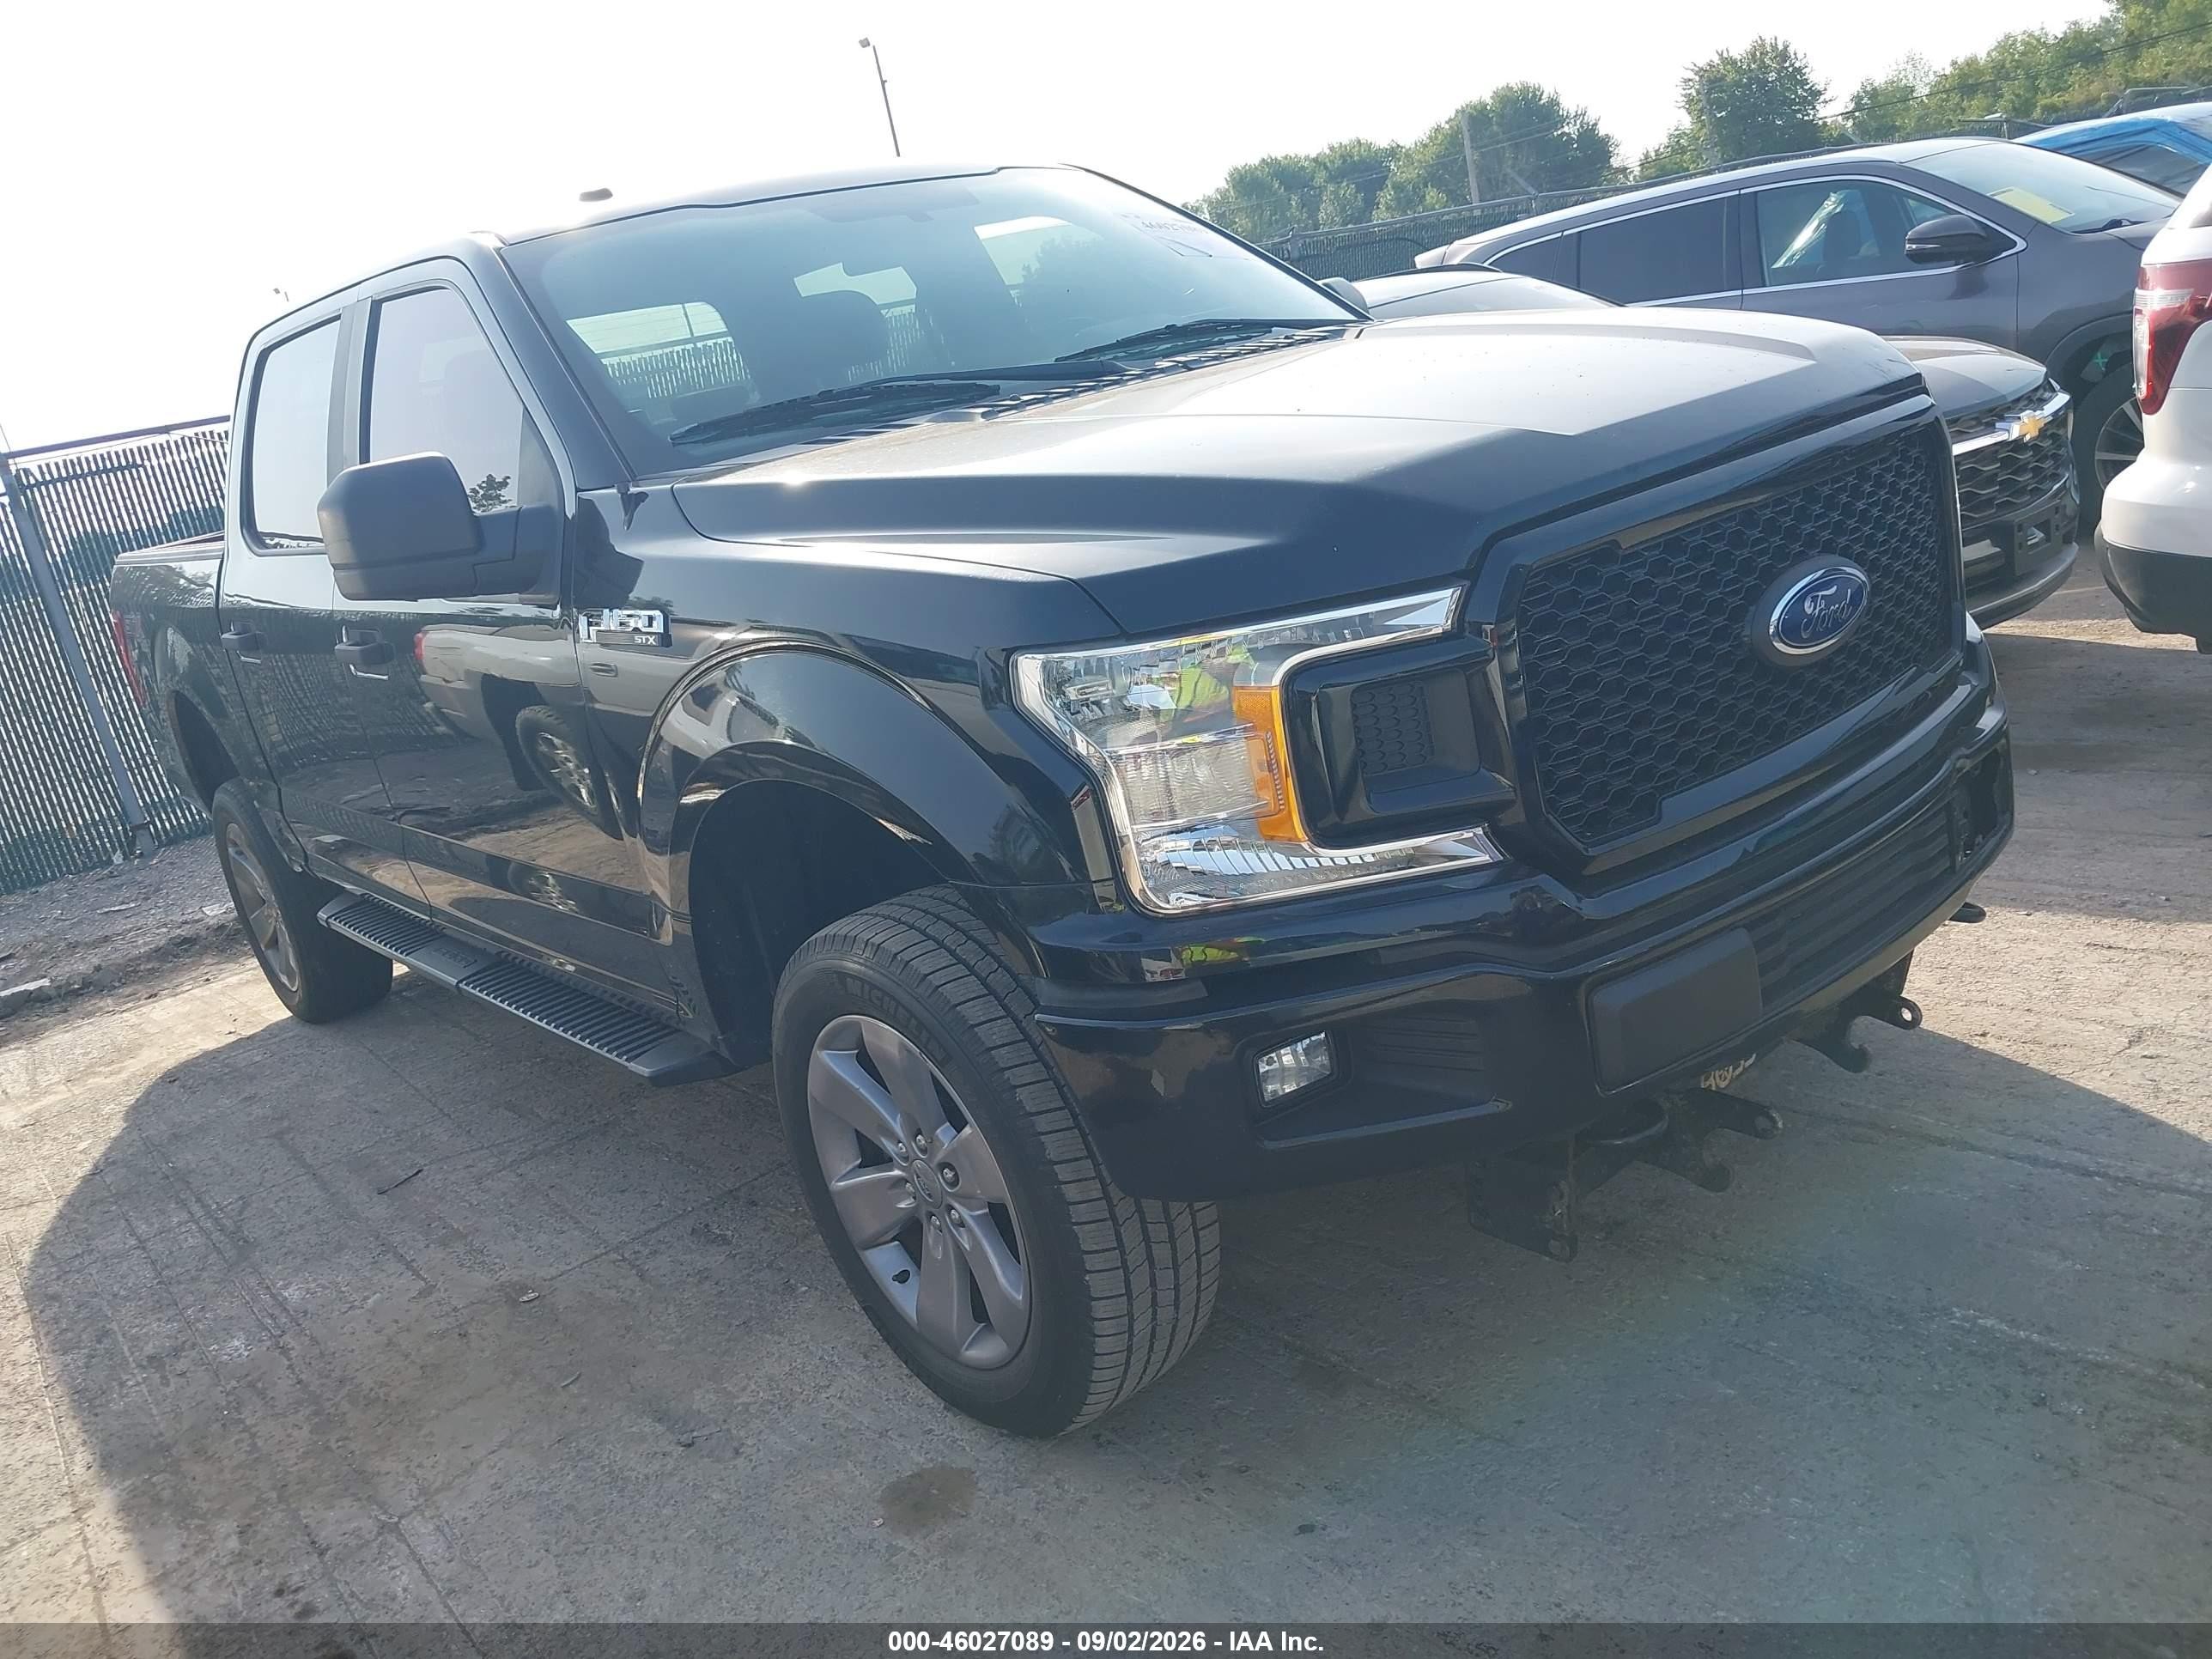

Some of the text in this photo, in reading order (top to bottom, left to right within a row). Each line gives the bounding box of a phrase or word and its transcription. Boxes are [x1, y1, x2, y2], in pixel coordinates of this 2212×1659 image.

[1801, 585, 1853, 639] Ford
[634, 635, 657, 645] STX
[842, 975, 952, 1067] MICHELIN
